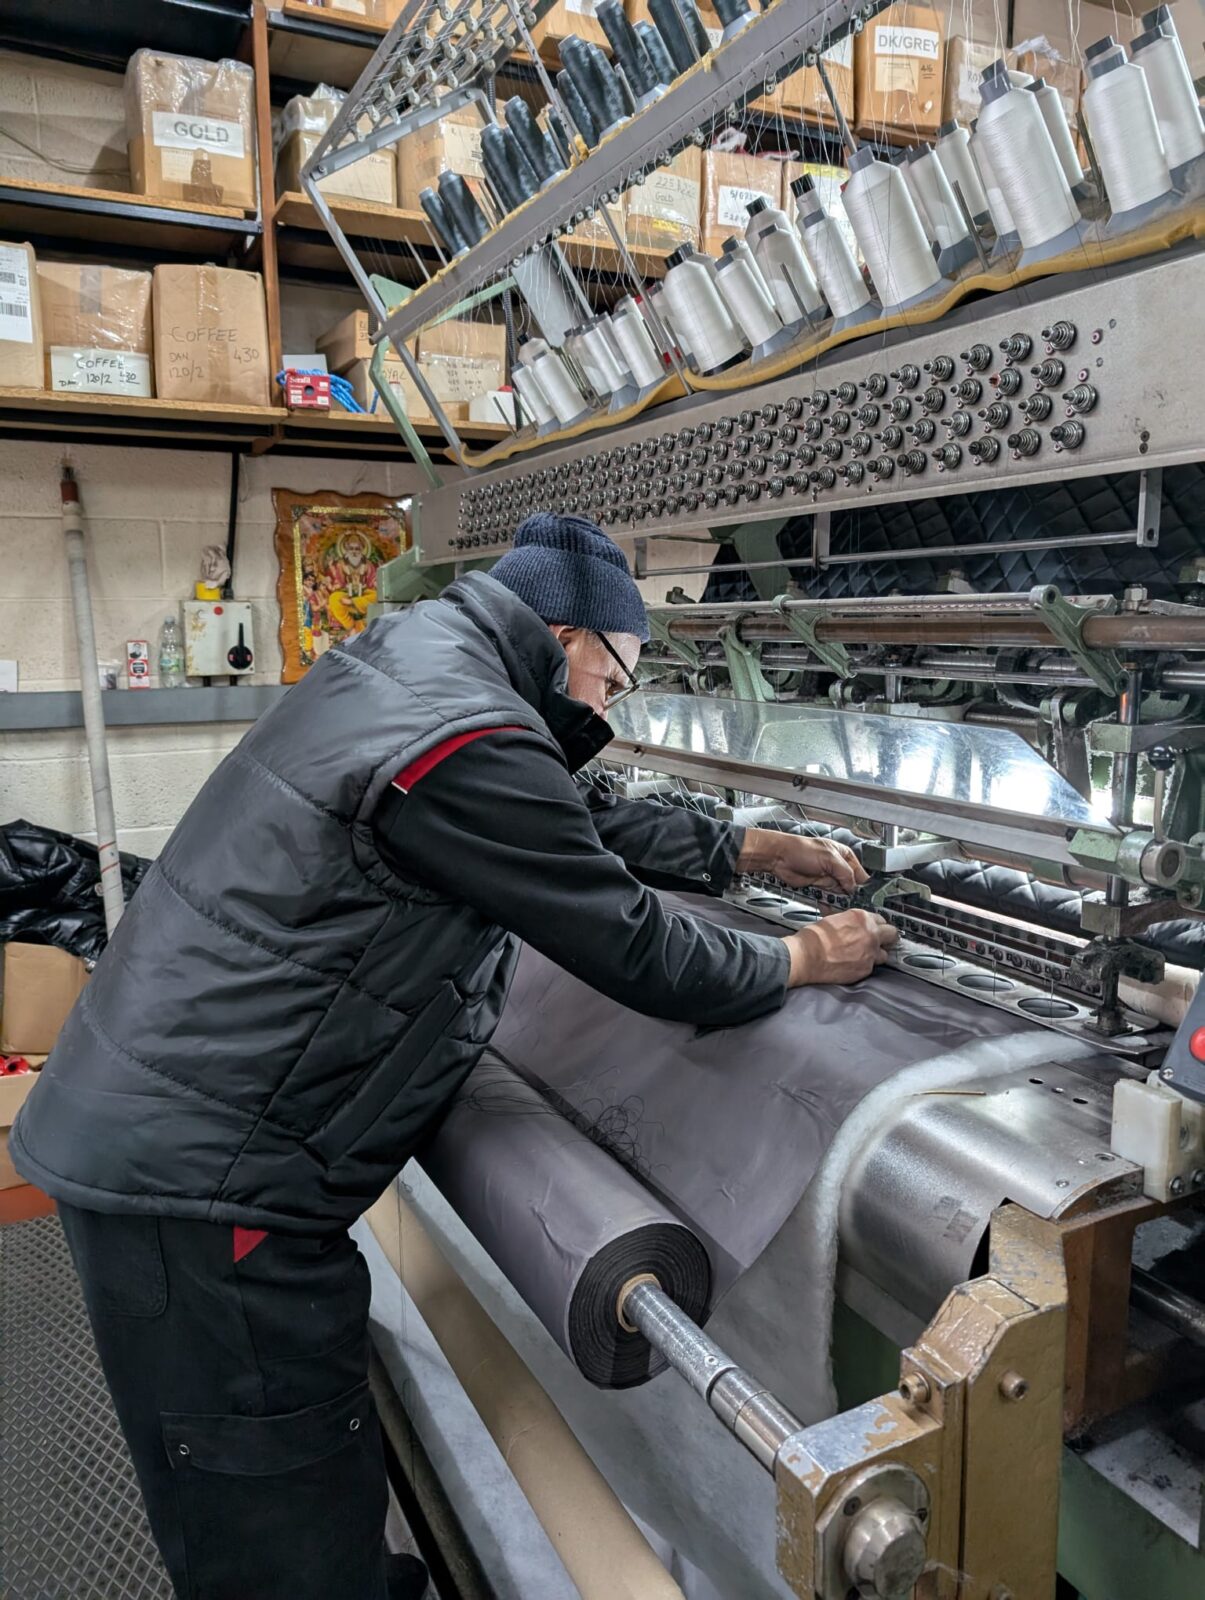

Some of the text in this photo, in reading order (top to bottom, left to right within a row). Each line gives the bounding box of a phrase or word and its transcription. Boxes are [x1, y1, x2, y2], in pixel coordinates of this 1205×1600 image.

[878, 34, 939, 54] DK/GREY
[173, 121, 229, 142] GOLD
[170, 326, 238, 342] COFFEE
[76, 357, 124, 369] COFFEE
[233, 346, 259, 364] 430
[86, 373, 113, 386] 120/2
[169, 360, 204, 383] 120/2
